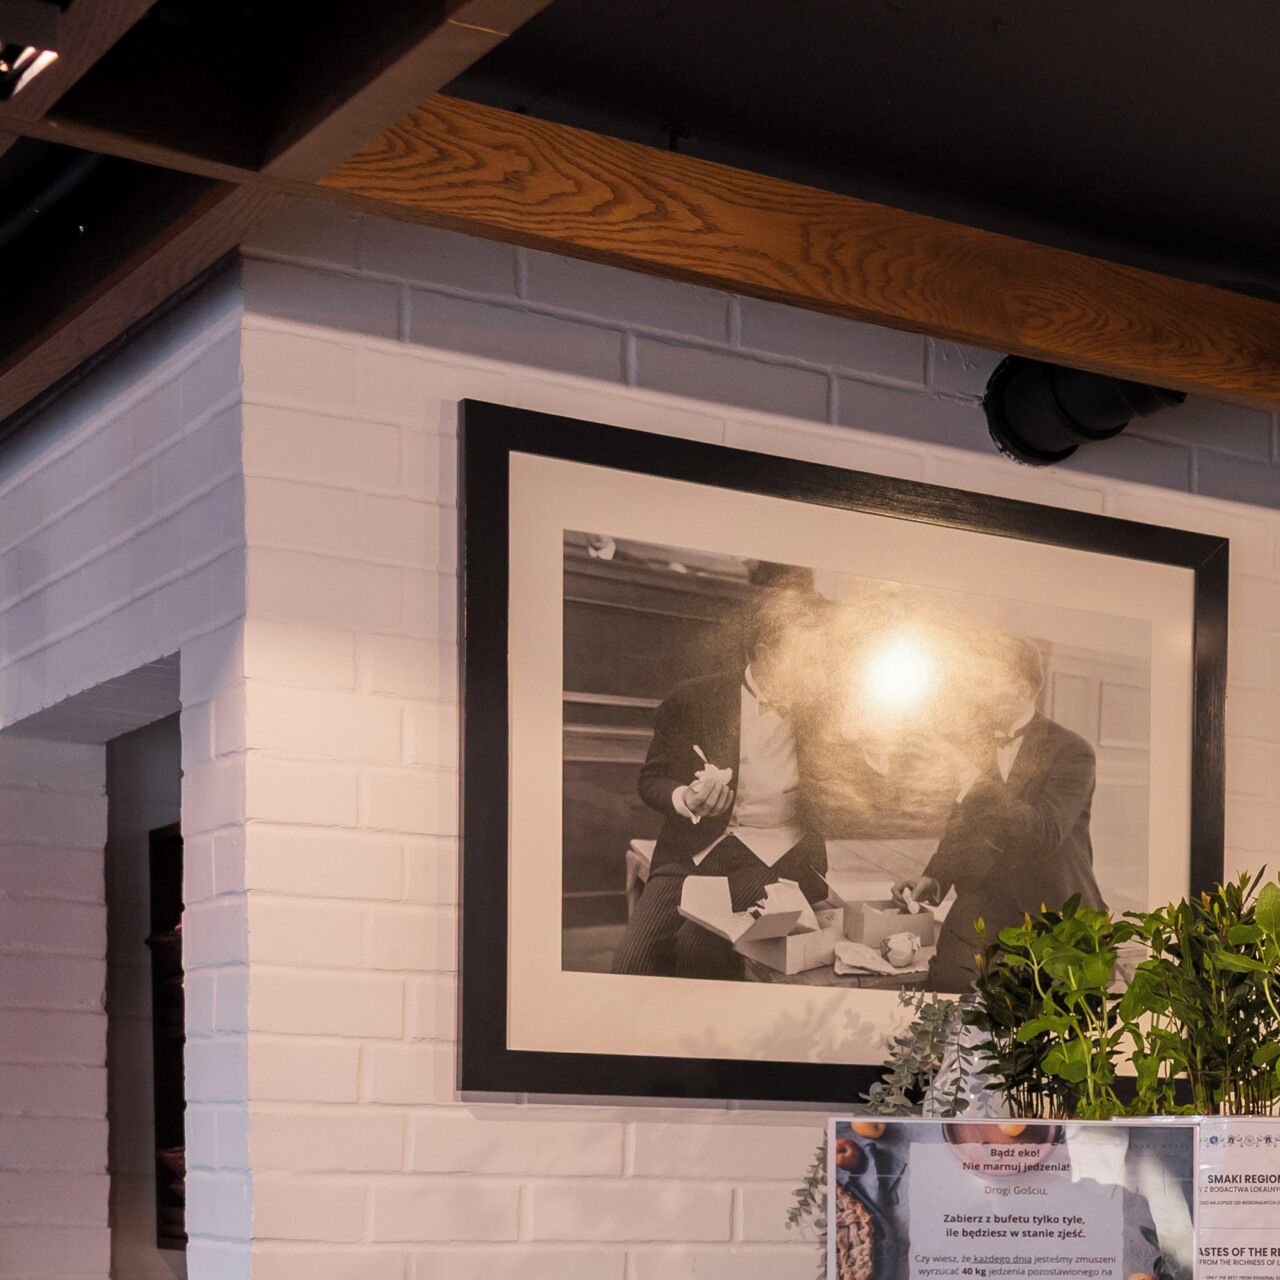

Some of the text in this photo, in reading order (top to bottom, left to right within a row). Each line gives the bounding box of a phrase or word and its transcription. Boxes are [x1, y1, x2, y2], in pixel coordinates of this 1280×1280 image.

[990, 1148, 1040, 1159] Bądź eko!
[962, 1162, 1070, 1174] Nie marnuj jedzenia!
[1207, 1174, 1242, 1184] SMAKI
[984, 1185, 1048, 1197] Drogi Gościu,
[943, 1214, 984, 1224] Zabierz
[985, 1216, 992, 1224] z
[994, 1214, 1030, 1224] bufetu
[1032, 1214, 1060, 1226] tylko
[946, 1228, 1086, 1240] ile będziesz w stanie zjeść.
[1199, 1247, 1228, 1257] ASTES
[1231, 1247, 1246, 1257] OF
[1248, 1247, 1268, 1257] THE
[915, 1254, 1116, 1265] Czy wiesz, że każdego dnia jesteśmy zmuszeni
[918, 1267, 960, 1277] wyrzucać
[962, 1268, 973, 1276] 40
[975, 1267, 987, 1277] kg
[988, 1268, 1025, 1277] jedzenia
[1027, 1268, 1099, 1278] pozostawionego
